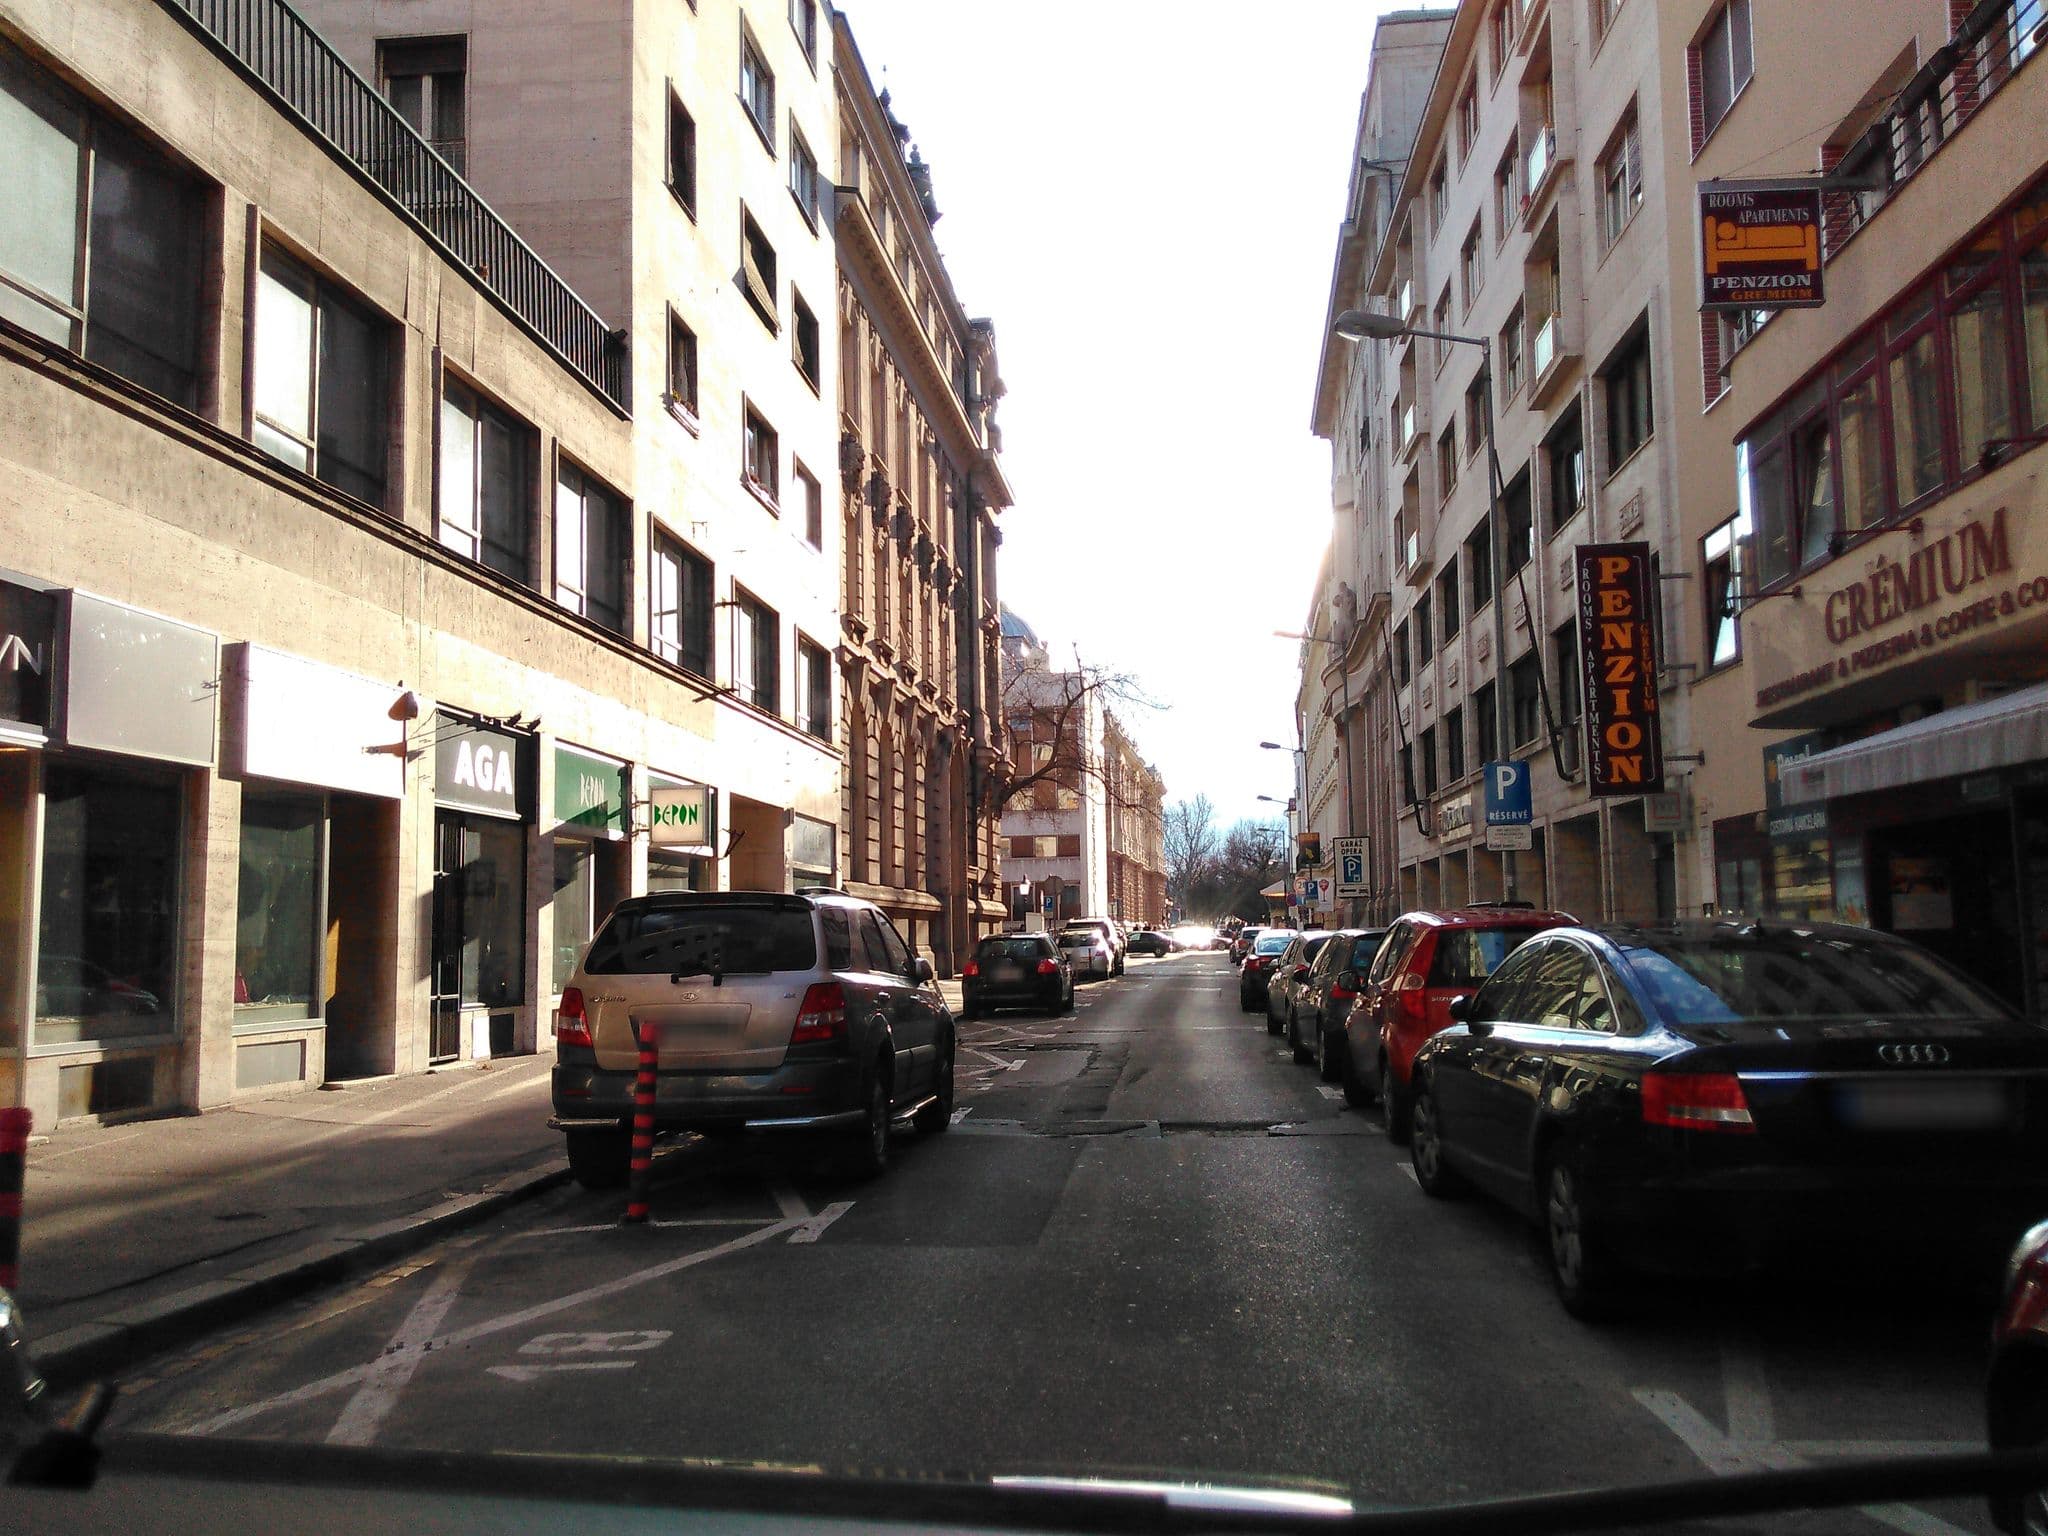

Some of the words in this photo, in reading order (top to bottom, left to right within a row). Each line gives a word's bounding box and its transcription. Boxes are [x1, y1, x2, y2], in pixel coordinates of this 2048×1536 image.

[1709, 193, 1755, 208] ROOMS
[1738, 207, 1810, 223] APARTMENTS
[1712, 274, 1811, 289] PENZION
[1825, 507, 2012, 645] GRÉMIUM
[1582, 567, 1594, 631] ROOMS
[1598, 556, 1643, 784] PENZION
[1586, 649, 1601, 776] APARTMENTS
[453, 740, 513, 795] AGA
[1497, 765, 1517, 800] P
[1340, 838, 1363, 848] GARÁŽ
[1340, 847, 1363, 855] OPERA
[1347, 861, 1357, 877] P
[1307, 882, 1315, 893] P
[1047, 897, 1052, 906] P
